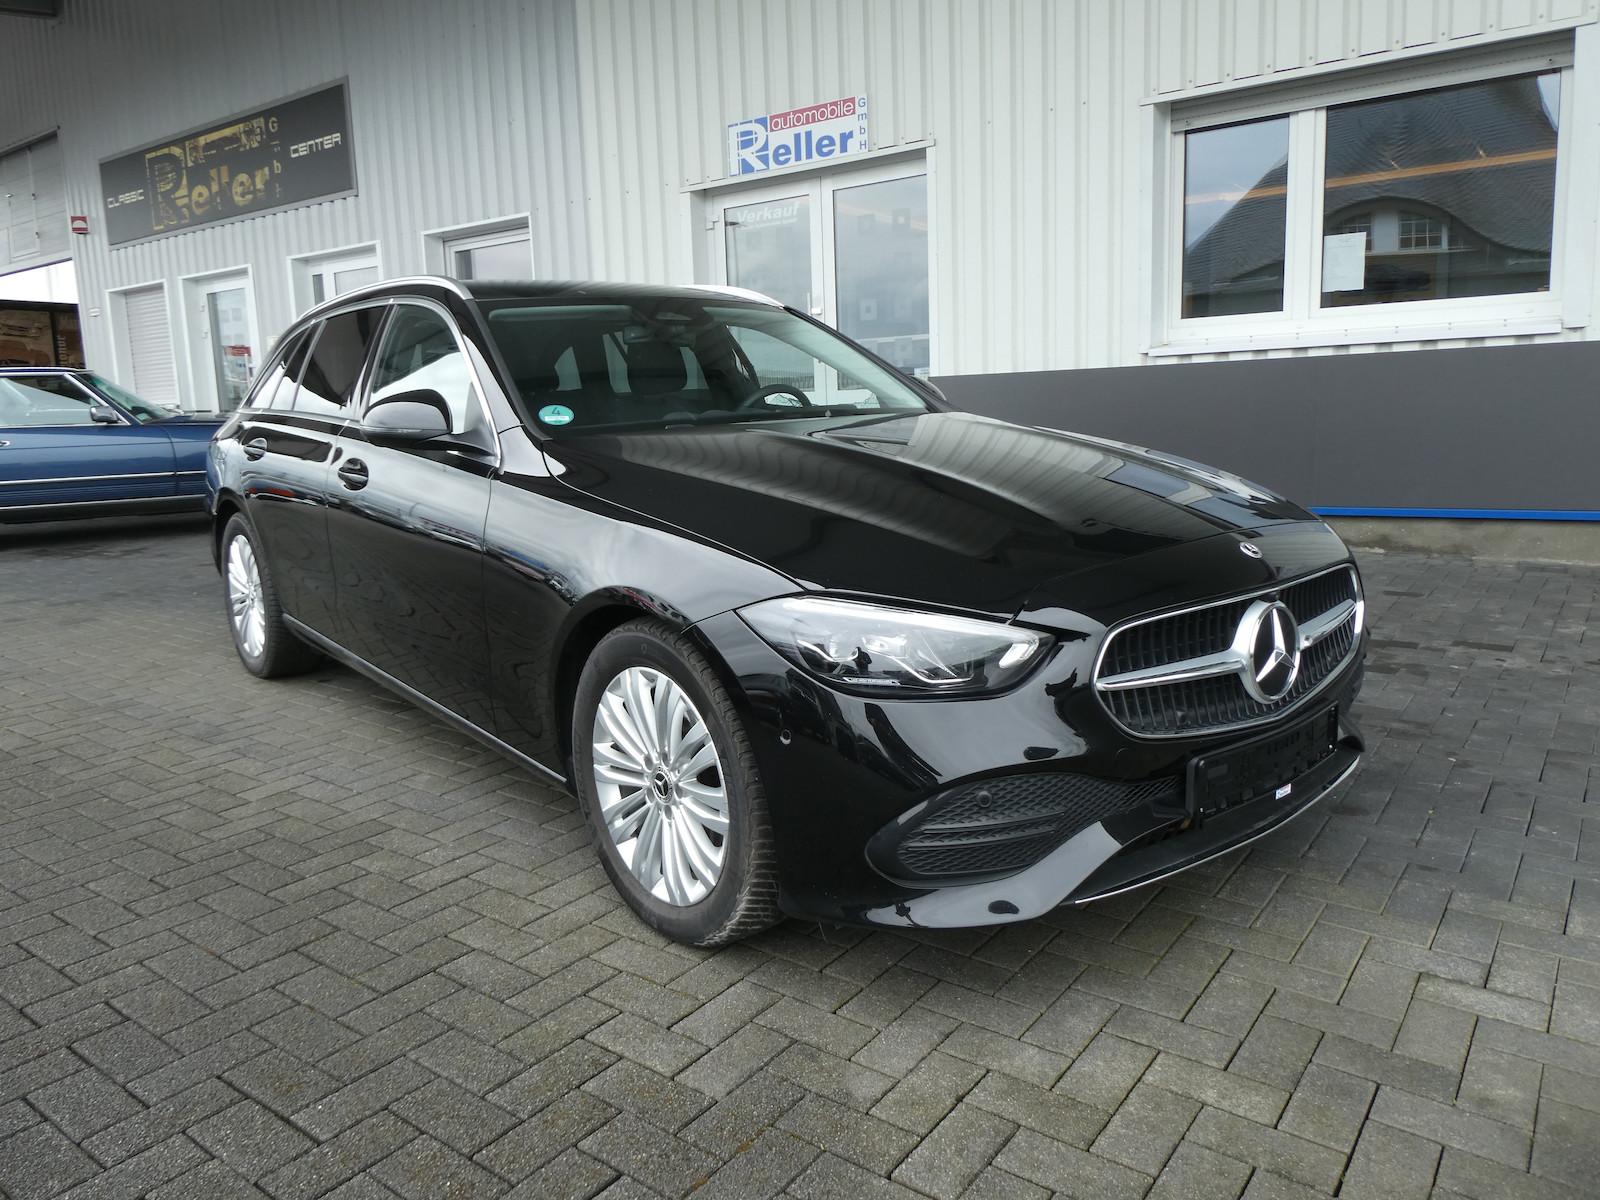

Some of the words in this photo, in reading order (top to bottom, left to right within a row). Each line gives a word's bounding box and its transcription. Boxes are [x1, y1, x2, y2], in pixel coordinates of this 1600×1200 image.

[771, 101, 854, 132] automobile
[290, 132, 343, 158] CENTER
[728, 121, 854, 176] Reller
[736, 201, 800, 223] Verkauf
